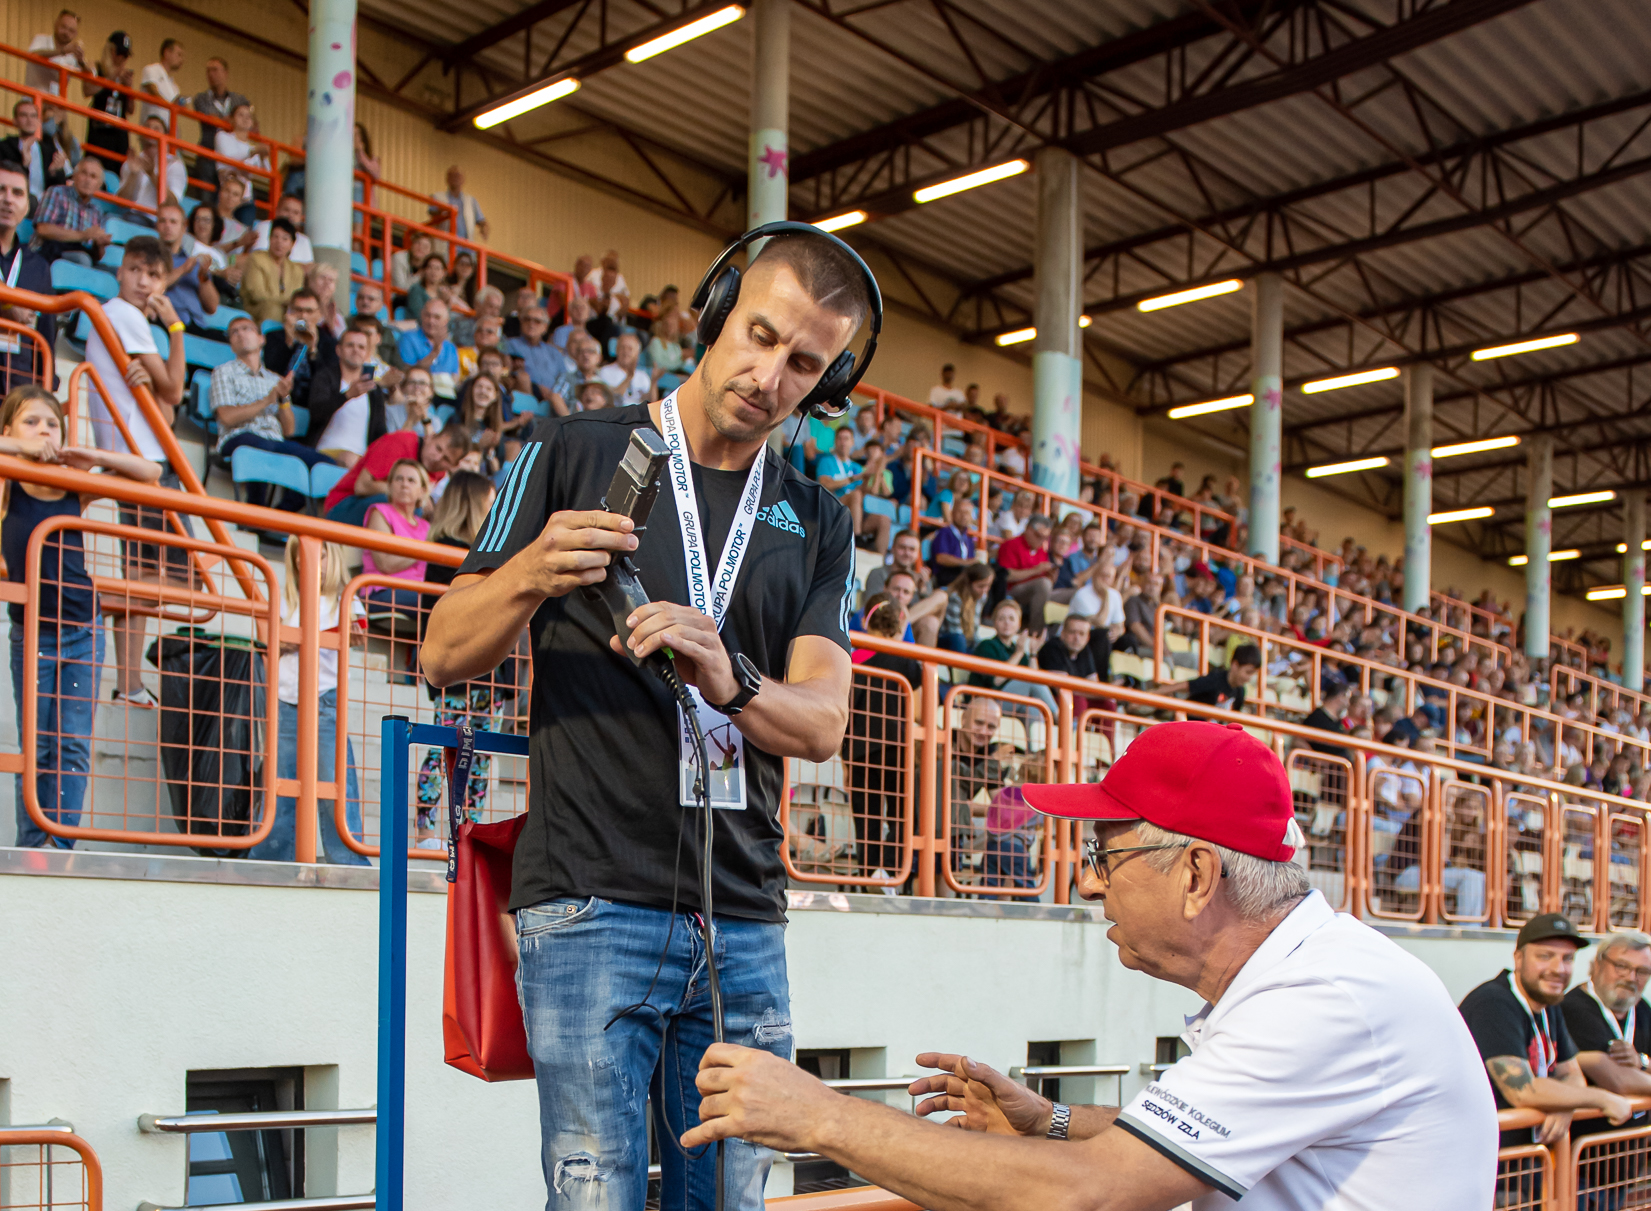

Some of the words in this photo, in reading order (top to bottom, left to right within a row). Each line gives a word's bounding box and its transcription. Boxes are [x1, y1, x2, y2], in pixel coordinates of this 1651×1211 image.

[663, 398, 676, 434] GRUPA
[743, 482, 760, 516] GRUPA
[682, 511, 698, 548] GRUPA
[756, 511, 806, 539] adidas
[713, 590, 727, 626] RUPA
[1187, 1106, 1232, 1139] KOLEGIUM
